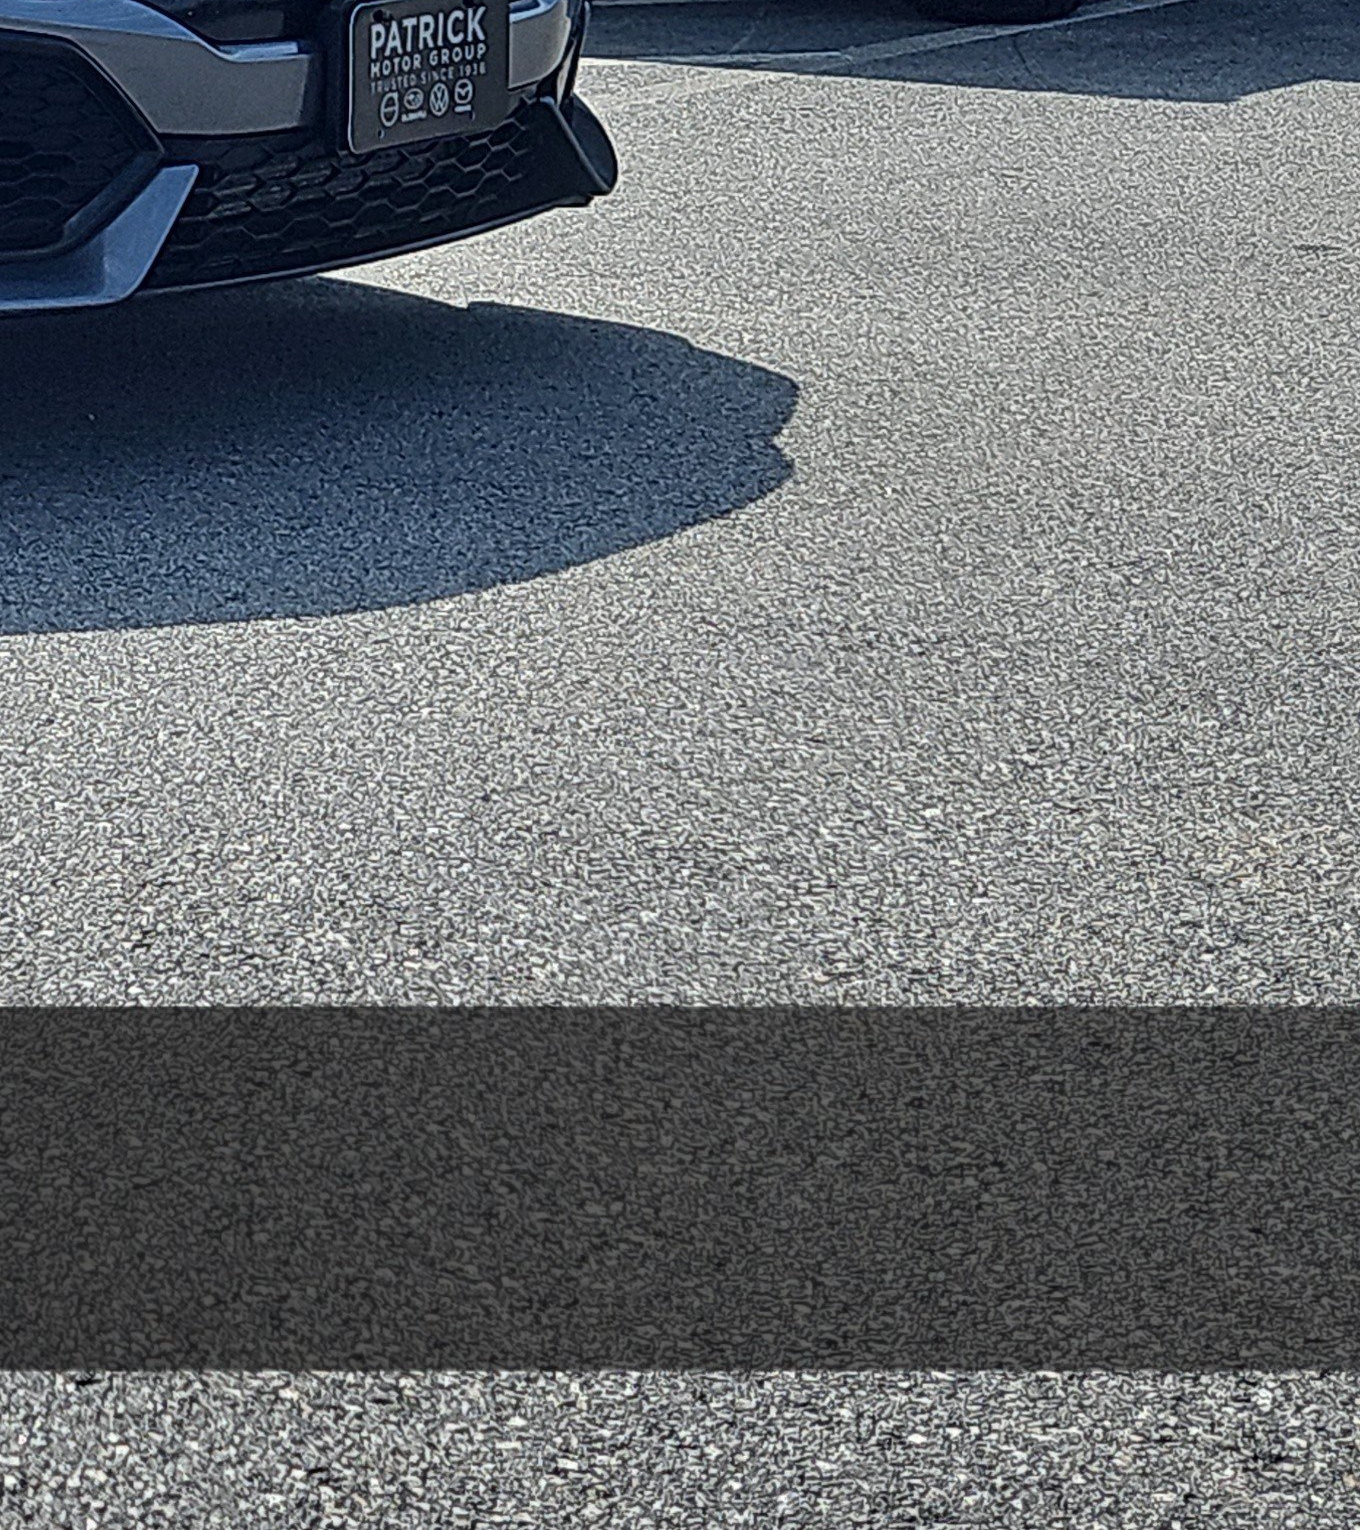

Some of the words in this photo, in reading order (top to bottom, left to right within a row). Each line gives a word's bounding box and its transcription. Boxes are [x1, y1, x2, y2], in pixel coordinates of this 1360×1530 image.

[370, 6, 486, 59] PATRICK
[370, 54, 421, 79] MOTOR
[429, 43, 487, 66] GROUP
